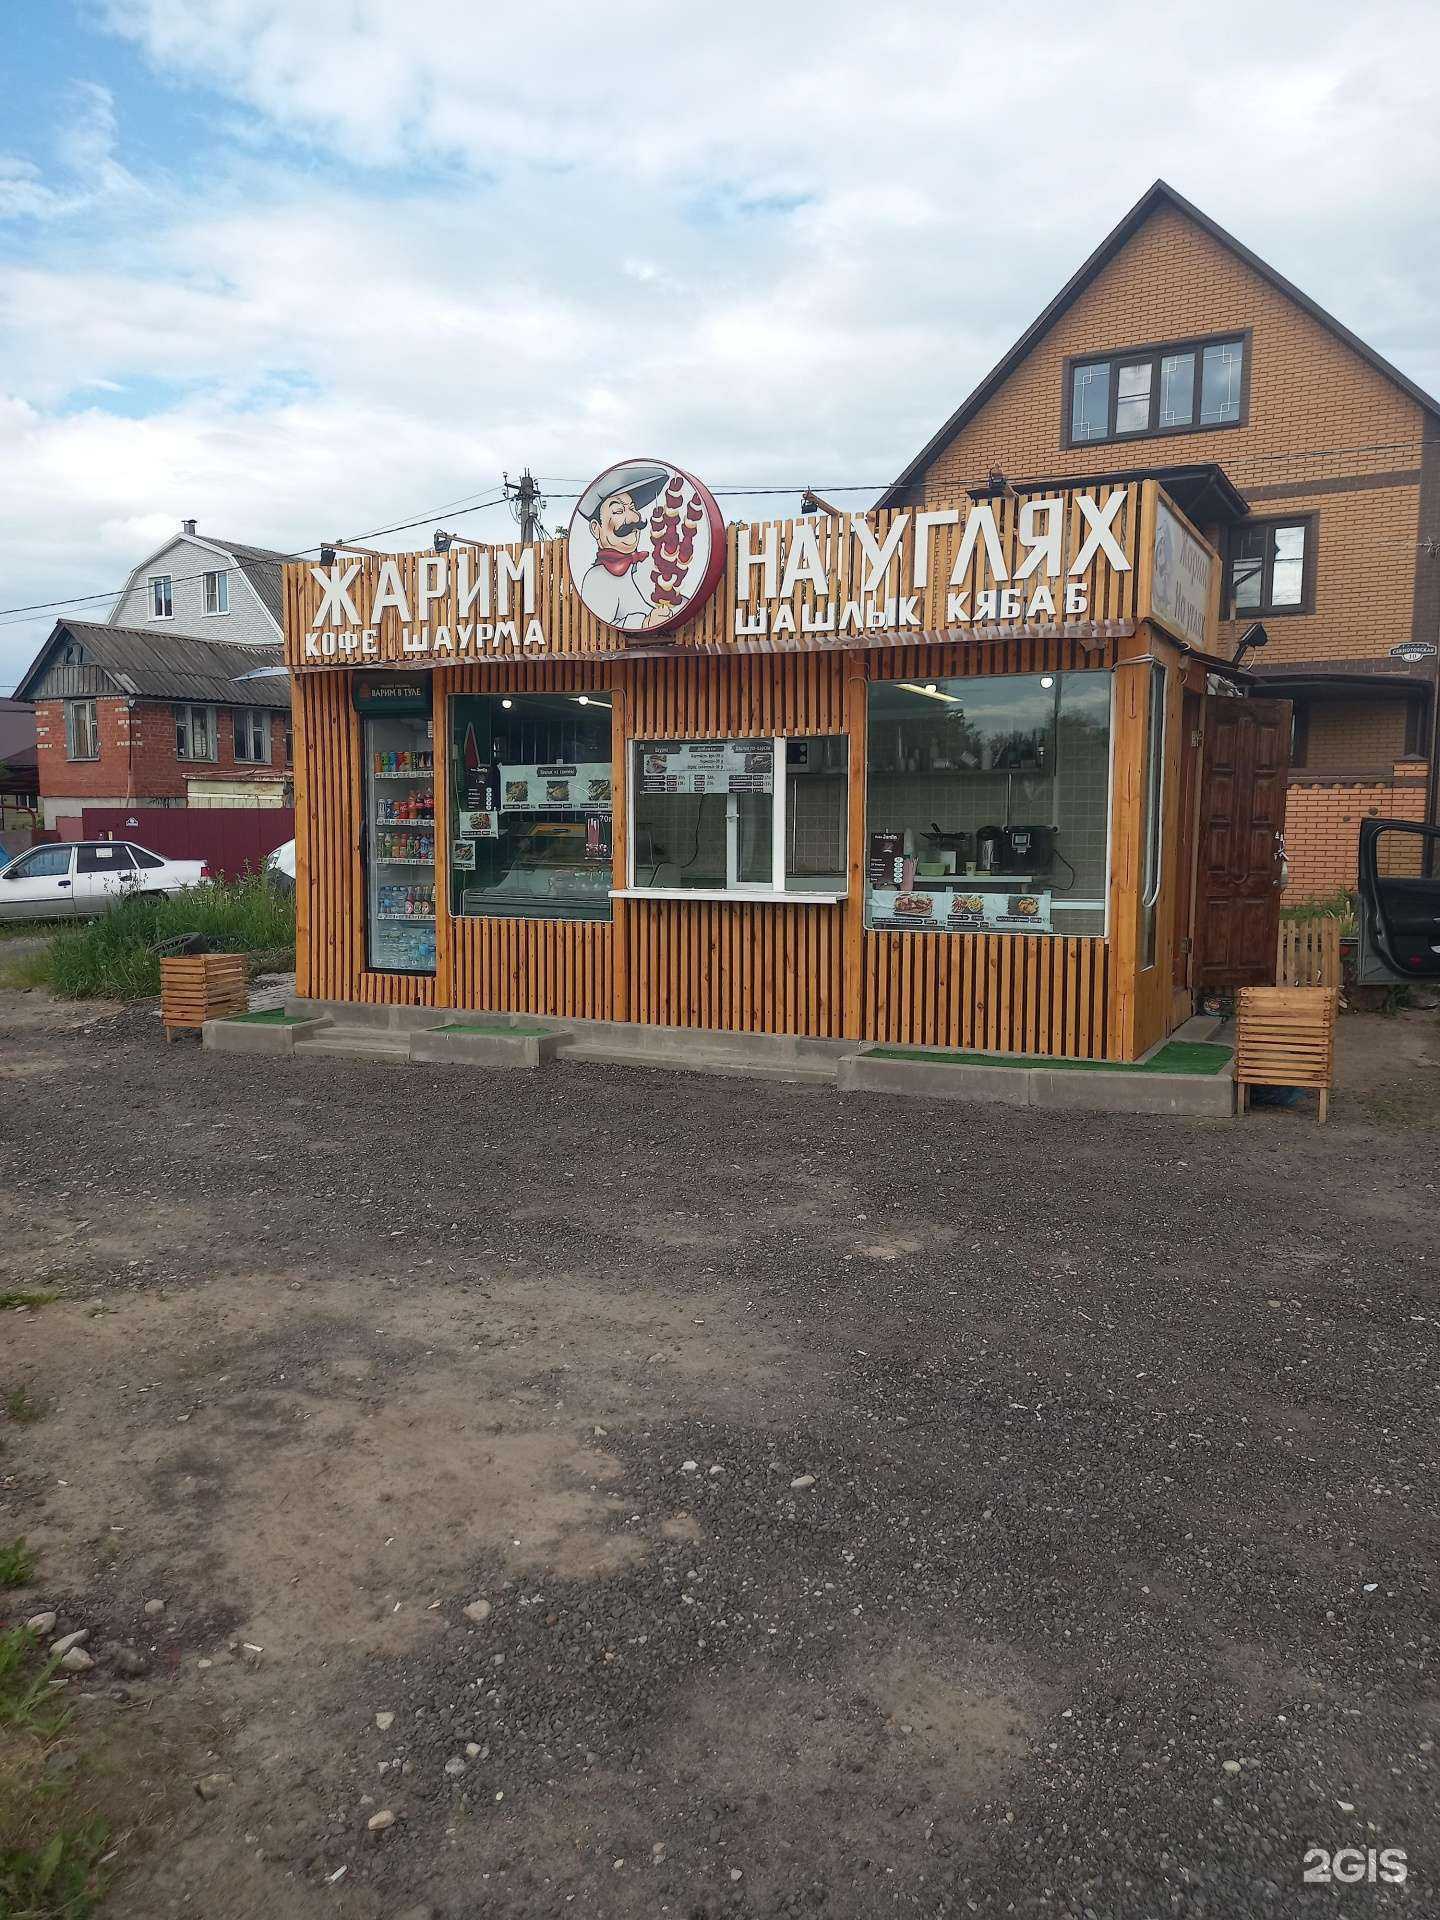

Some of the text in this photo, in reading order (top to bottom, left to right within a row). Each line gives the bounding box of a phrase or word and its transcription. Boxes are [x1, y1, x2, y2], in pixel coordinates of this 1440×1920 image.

[309, 547, 536, 628] ЖАРИМ
[735, 582, 1089, 636] ШАШЛЫК КЯБАБ
[305, 619, 546, 657] КОФЕ ШАУРМА
[371, 688, 421, 697] ВАРИМ В ТУЛЕ
